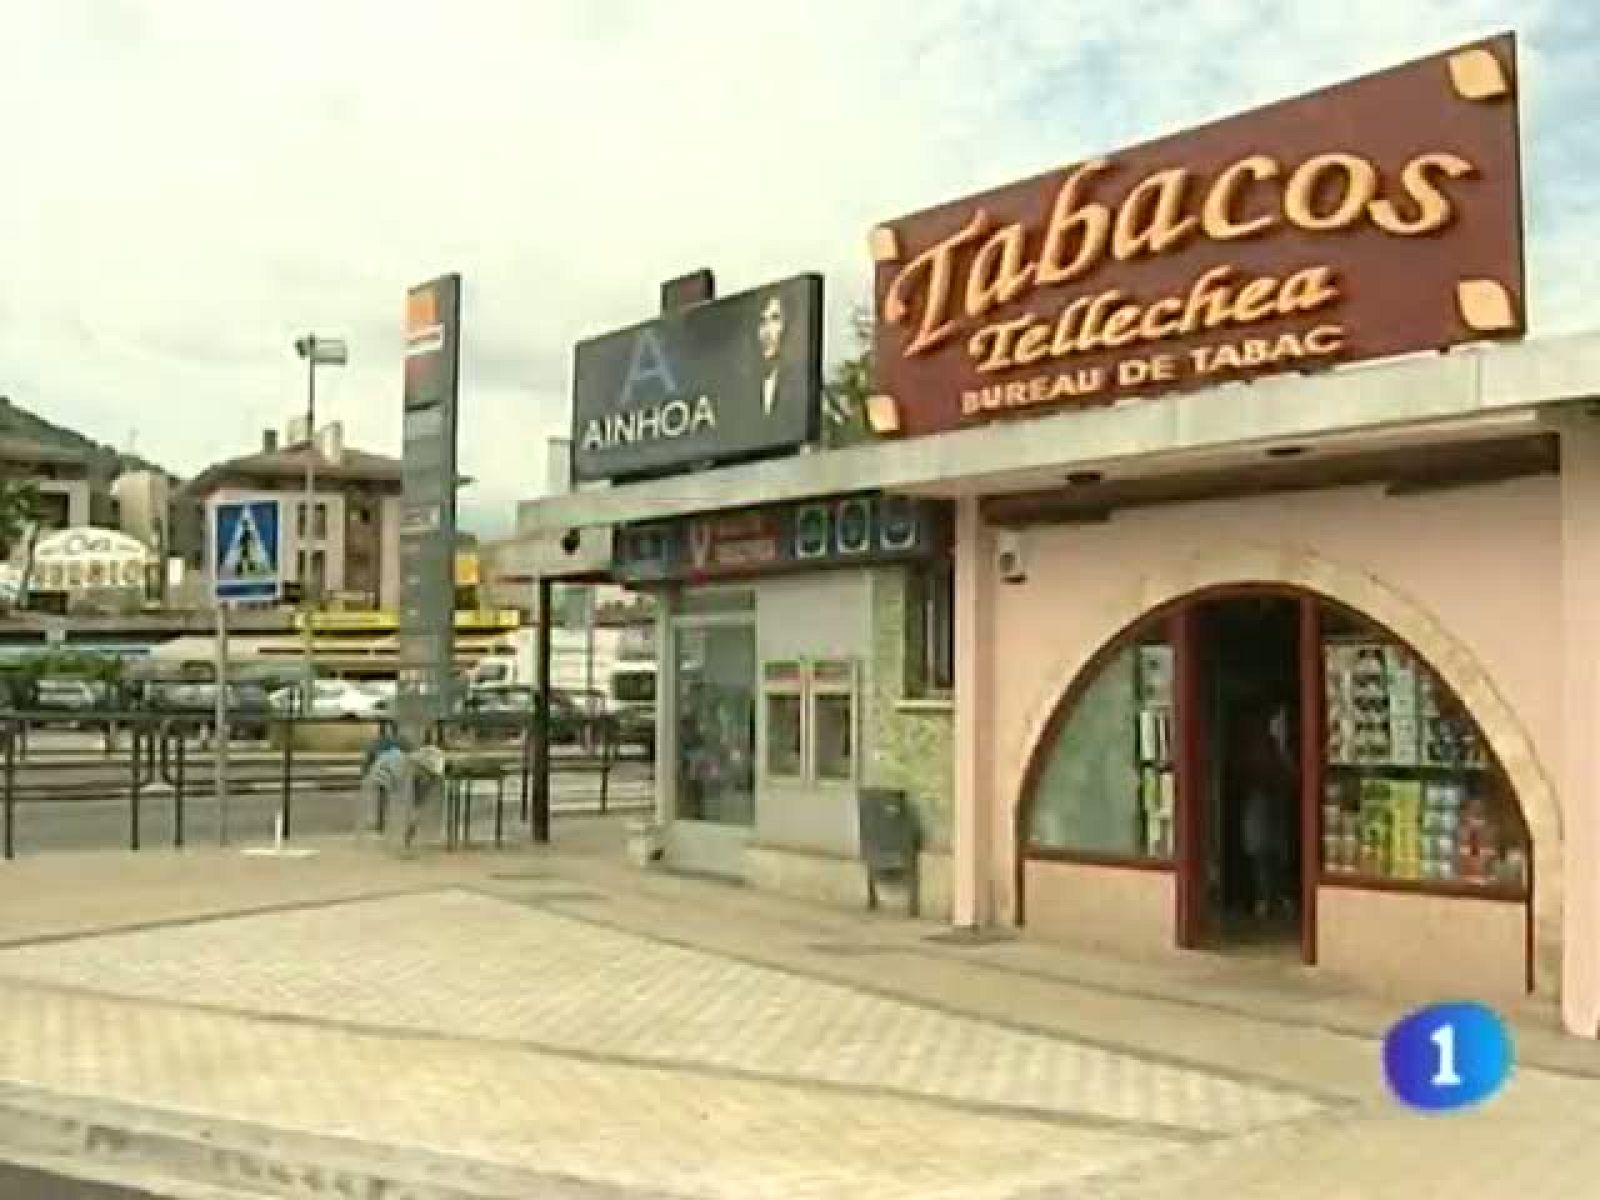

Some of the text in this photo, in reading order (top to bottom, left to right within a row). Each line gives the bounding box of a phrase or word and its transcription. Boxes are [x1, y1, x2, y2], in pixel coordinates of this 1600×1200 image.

[885, 151, 1474, 357] Tabacos
[968, 264, 1339, 373] Tellechea
[961, 327, 1346, 414] BUREAU DE TABAC
[583, 394, 717, 450] AINHOA
